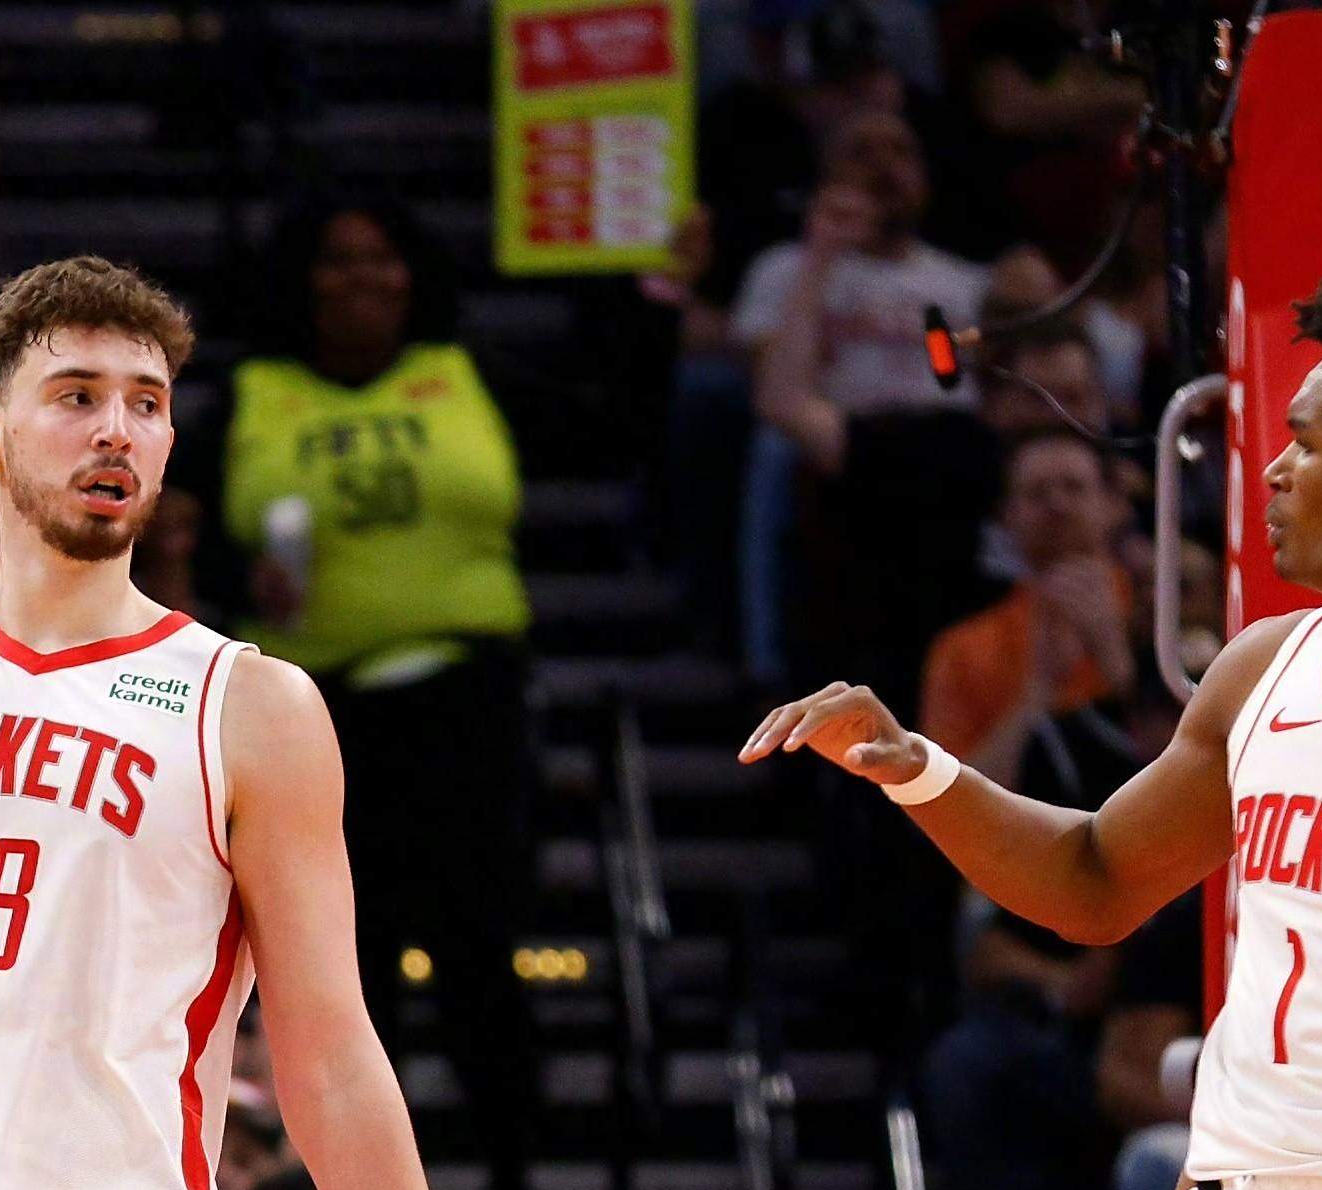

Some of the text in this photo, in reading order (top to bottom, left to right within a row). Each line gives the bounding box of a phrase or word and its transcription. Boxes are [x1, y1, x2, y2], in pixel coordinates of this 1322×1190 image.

[108, 683, 186, 714] karma
[119, 672, 191, 698] credit
[1273, 927, 1307, 1065] 1
